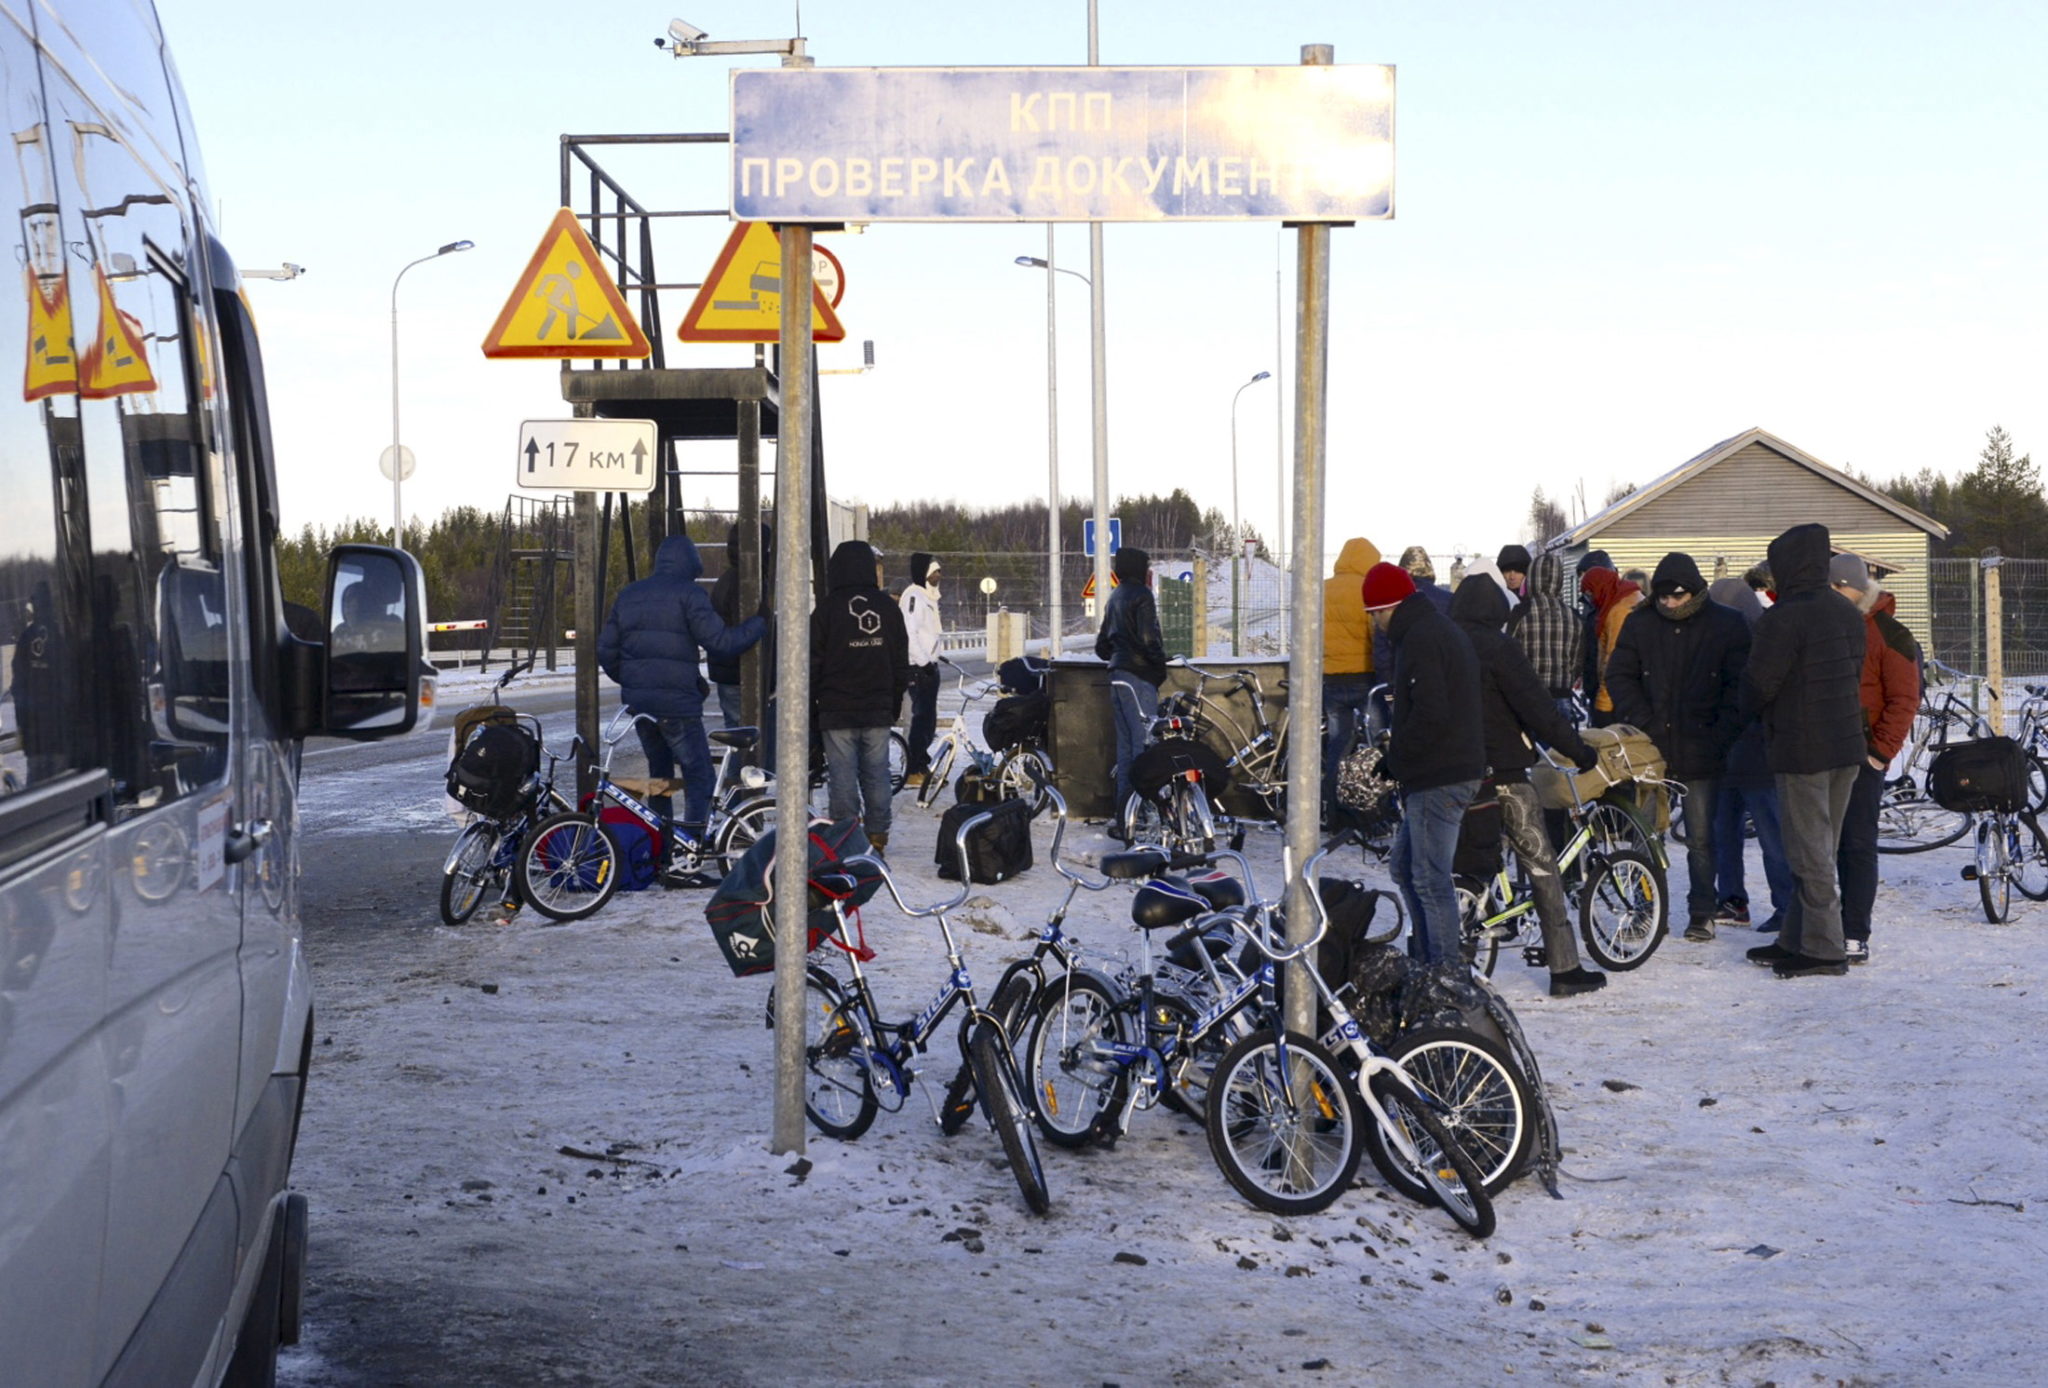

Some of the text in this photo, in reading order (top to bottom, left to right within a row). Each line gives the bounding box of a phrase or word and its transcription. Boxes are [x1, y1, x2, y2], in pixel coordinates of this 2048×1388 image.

[1010, 92, 1113, 132] КПП
[741, 156, 1310, 197] ПРОВЕРКА ДОКУМЕН
[545, 442, 579, 467] 17
[606, 784, 658, 822] STELS
[914, 981, 955, 1033] STELS
[1197, 978, 1256, 1029] STELS
